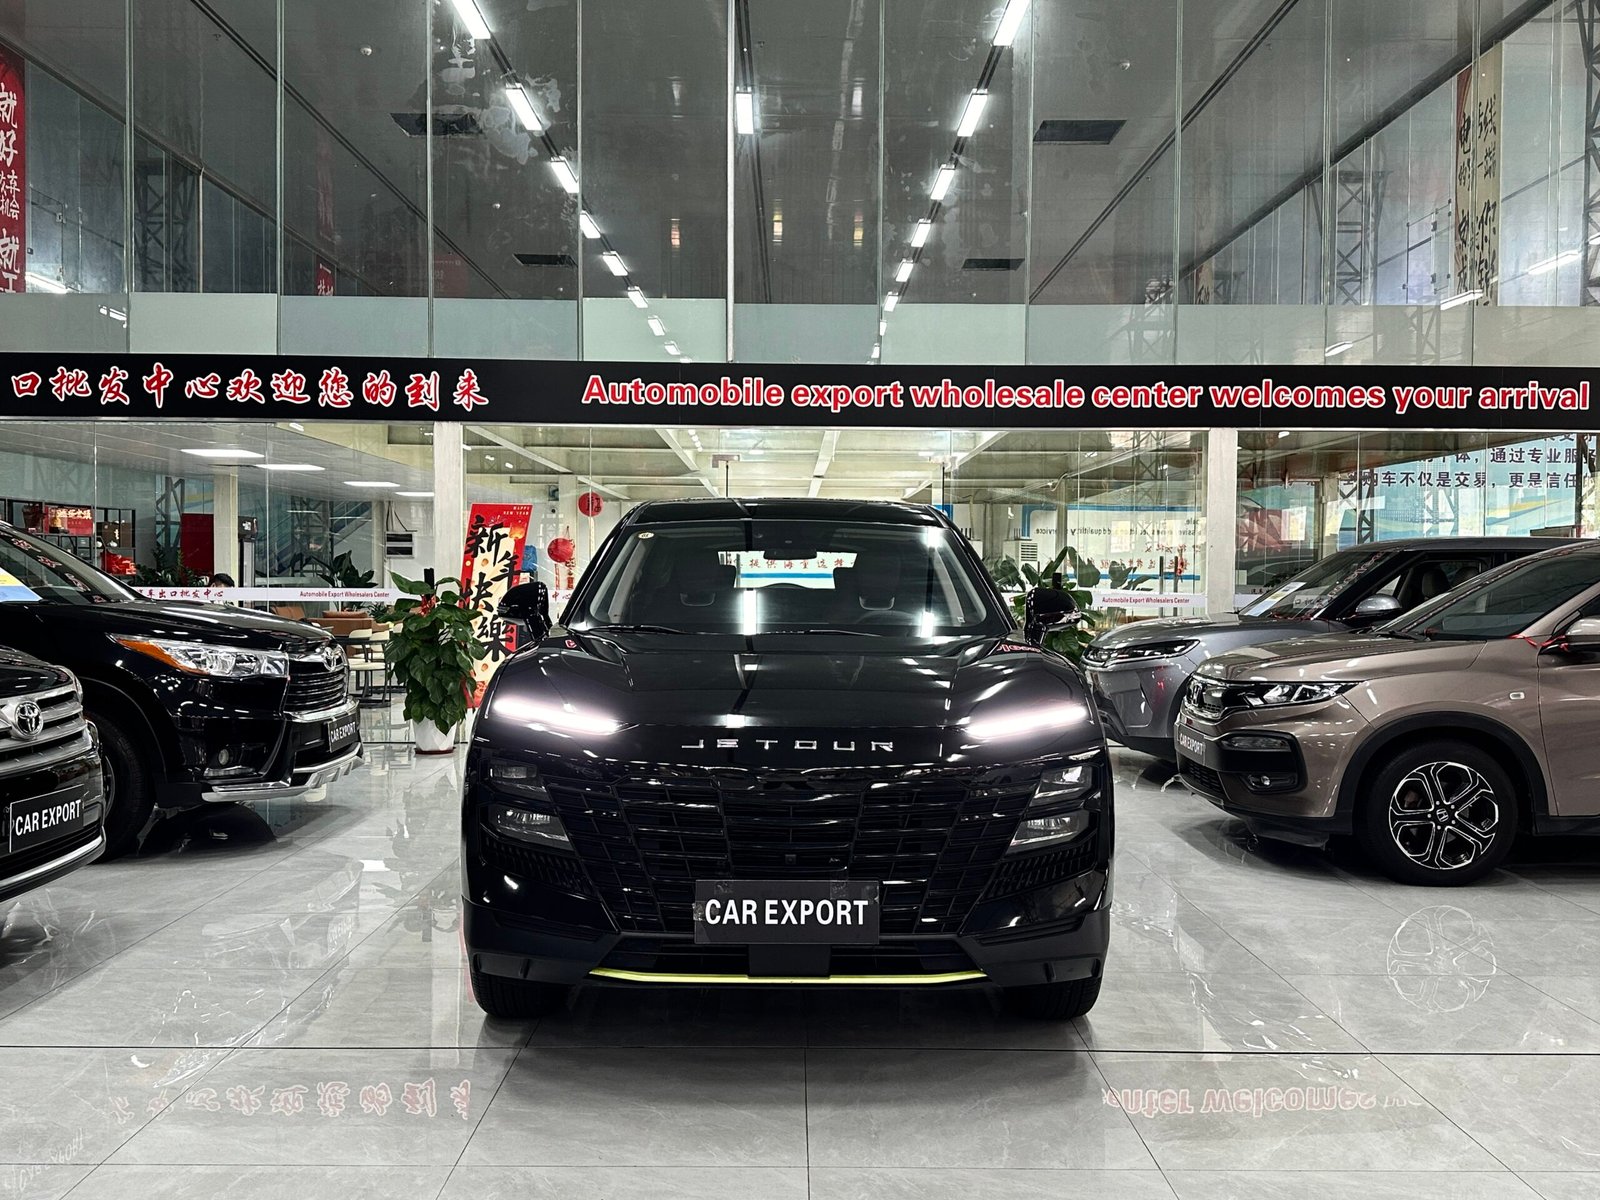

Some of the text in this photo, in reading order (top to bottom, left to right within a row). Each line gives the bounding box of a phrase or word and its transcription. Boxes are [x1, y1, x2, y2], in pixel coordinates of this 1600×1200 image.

[11, 362, 489, 411] 口批发中心欢迎您的到来
[582, 375, 1590, 414] Automobile export wholesale center welcomes your arrival
[330, 722, 356, 743] CAR EXPORT
[681, 738, 893, 752] JETOUR
[1179, 733, 1203, 755] CAR EXPORT
[15, 799, 82, 836] CAR EXPORT
[705, 898, 868, 926] CAR EXPORT
